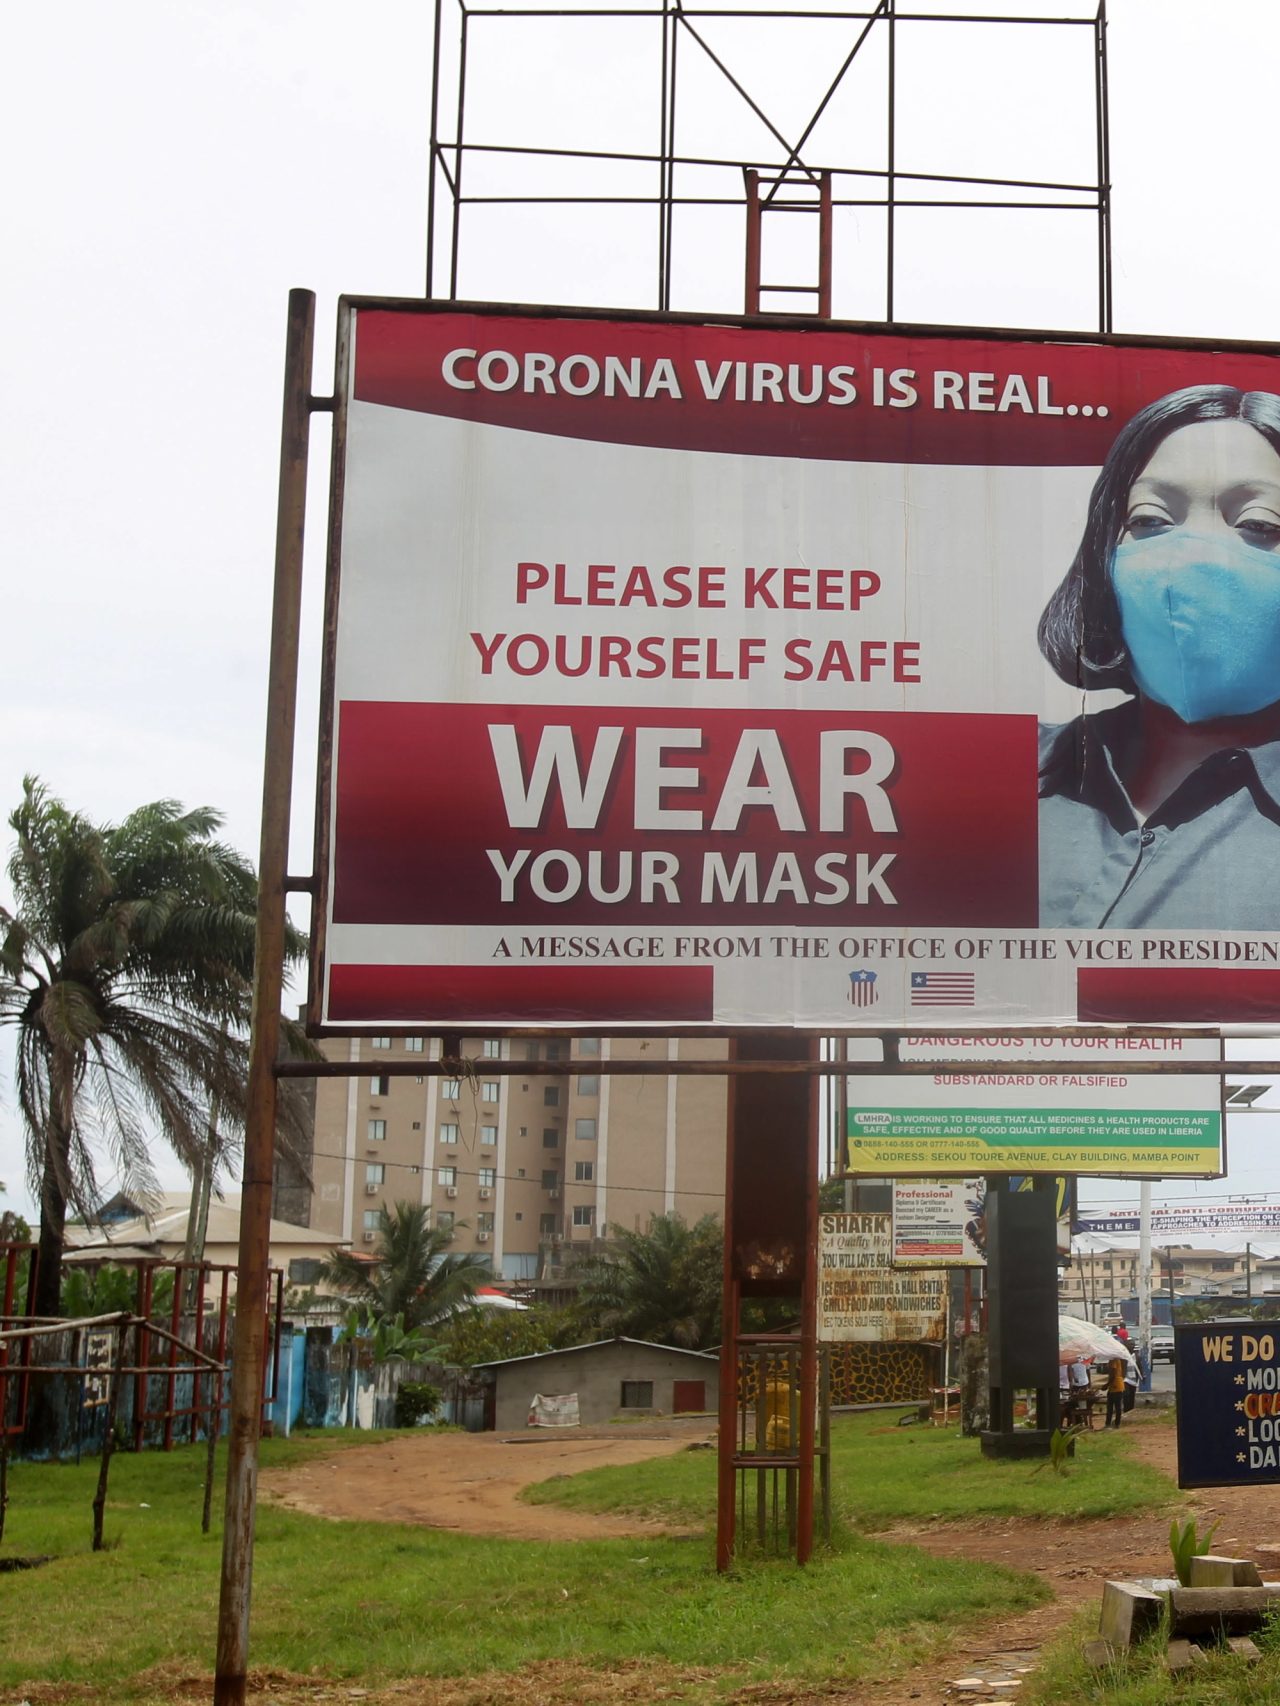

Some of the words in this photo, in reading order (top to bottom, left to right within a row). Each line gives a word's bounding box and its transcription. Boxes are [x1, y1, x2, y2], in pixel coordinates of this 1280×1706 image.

[441, 348, 680, 402] CORONA
[693, 360, 856, 406] VIRUS
[873, 368, 918, 409] IS
[933, 372, 1109, 419] REAL...
[516, 562, 726, 609] PLEASE
[744, 567, 881, 611] KEEP
[470, 634, 767, 682] YOURSELF
[783, 640, 923, 684] SAFE
[488, 724, 898, 833] WEAR
[486, 849, 681, 905] YOUR
[701, 852, 898, 907] MASK
[492, 937, 511, 957] A
[520, 936, 664, 958] MESSAGE
[673, 936, 761, 958] FROM
[770, 937, 829, 959] THE
[838, 937, 945, 960] OFFICE
[954, 938, 993, 960] OF
[1000, 938, 1057, 960] THE
[1064, 939, 1133, 961] VICE
[907, 1037, 1024, 1047] DANGEROUS
[1033, 1038, 1053, 1048] TO
[1061, 1038, 1109, 1049] YOUR
[1115, 1038, 1183, 1050] HEALTH
[934, 1075, 1034, 1086] SUBSTANDARD
[1039, 1076, 1058, 1086] OR
[1062, 1076, 1128, 1087] FALSIFIED
[857, 1115, 891, 1123] LMHRA
[892, 1115, 902, 1123] IS
[904, 1115, 948, 1124] WORKING
[950, 1115, 963, 1124] TO
[965, 1115, 1001, 1124] ENSURE
[1004, 1115, 1028, 1124] THAT
[1028, 1116, 1046, 1124] ALL
[1048, 1116, 1095, 1124] MEDICINES
[1106, 1116, 1141, 1125] HEALTH
[1142, 1117, 1190, 1125] PRODUCTS
[1191, 1117, 1210, 1126] ARE
[863, 1126, 890, 1135] SAFE,
[892, 1126, 941, 1134] EFFECTIVE
[943, 1126, 963, 1134] AND
[966, 1126, 978, 1135] OF
[979, 1126, 1008, 1135] GOOD
[1009, 1126, 1048, 1135] QUALITY
[1050, 1126, 1086, 1135] BEFORE
[1088, 1127, 1112, 1135] THEY
[1112, 1127, 1131, 1135] ARE
[1132, 1127, 1156, 1135] USED
[1158, 1127, 1167, 1135] IN
[1168, 1127, 1203, 1136] LIBERIA
[875, 1153, 927, 1161] ADDRESS:
[931, 1153, 967, 1161] SEKOU
[970, 1153, 1005, 1162] TOURE
[1006, 1153, 1050, 1162] AVENUE,
[1052, 1153, 1077, 1161] CLAY
[1080, 1153, 1130, 1163] BUILDING,
[1132, 1153, 1168, 1162] MAMBA
[1171, 1154, 1200, 1162] POINT
[895, 1190, 953, 1198] Professional
[822, 1215, 891, 1234] SHARK'
[1089, 1222, 1135, 1231] THEME:
[1152, 1222, 1204, 1230] APPROACHES
[872, 1236, 891, 1247] Wor
[822, 1253, 837, 1268] YOU
[838, 1253, 855, 1268] WILL
[857, 1253, 875, 1268] LOVE
[876, 1253, 891, 1268] SHA
[901, 1280, 917, 1294] HALL
[919, 1280, 944, 1295] RENTAL
[869, 1298, 885, 1312] AND
[886, 1297, 941, 1312] SANDWICHES
[1202, 1335, 1233, 1362] WE
[1241, 1334, 1275, 1361] DO
